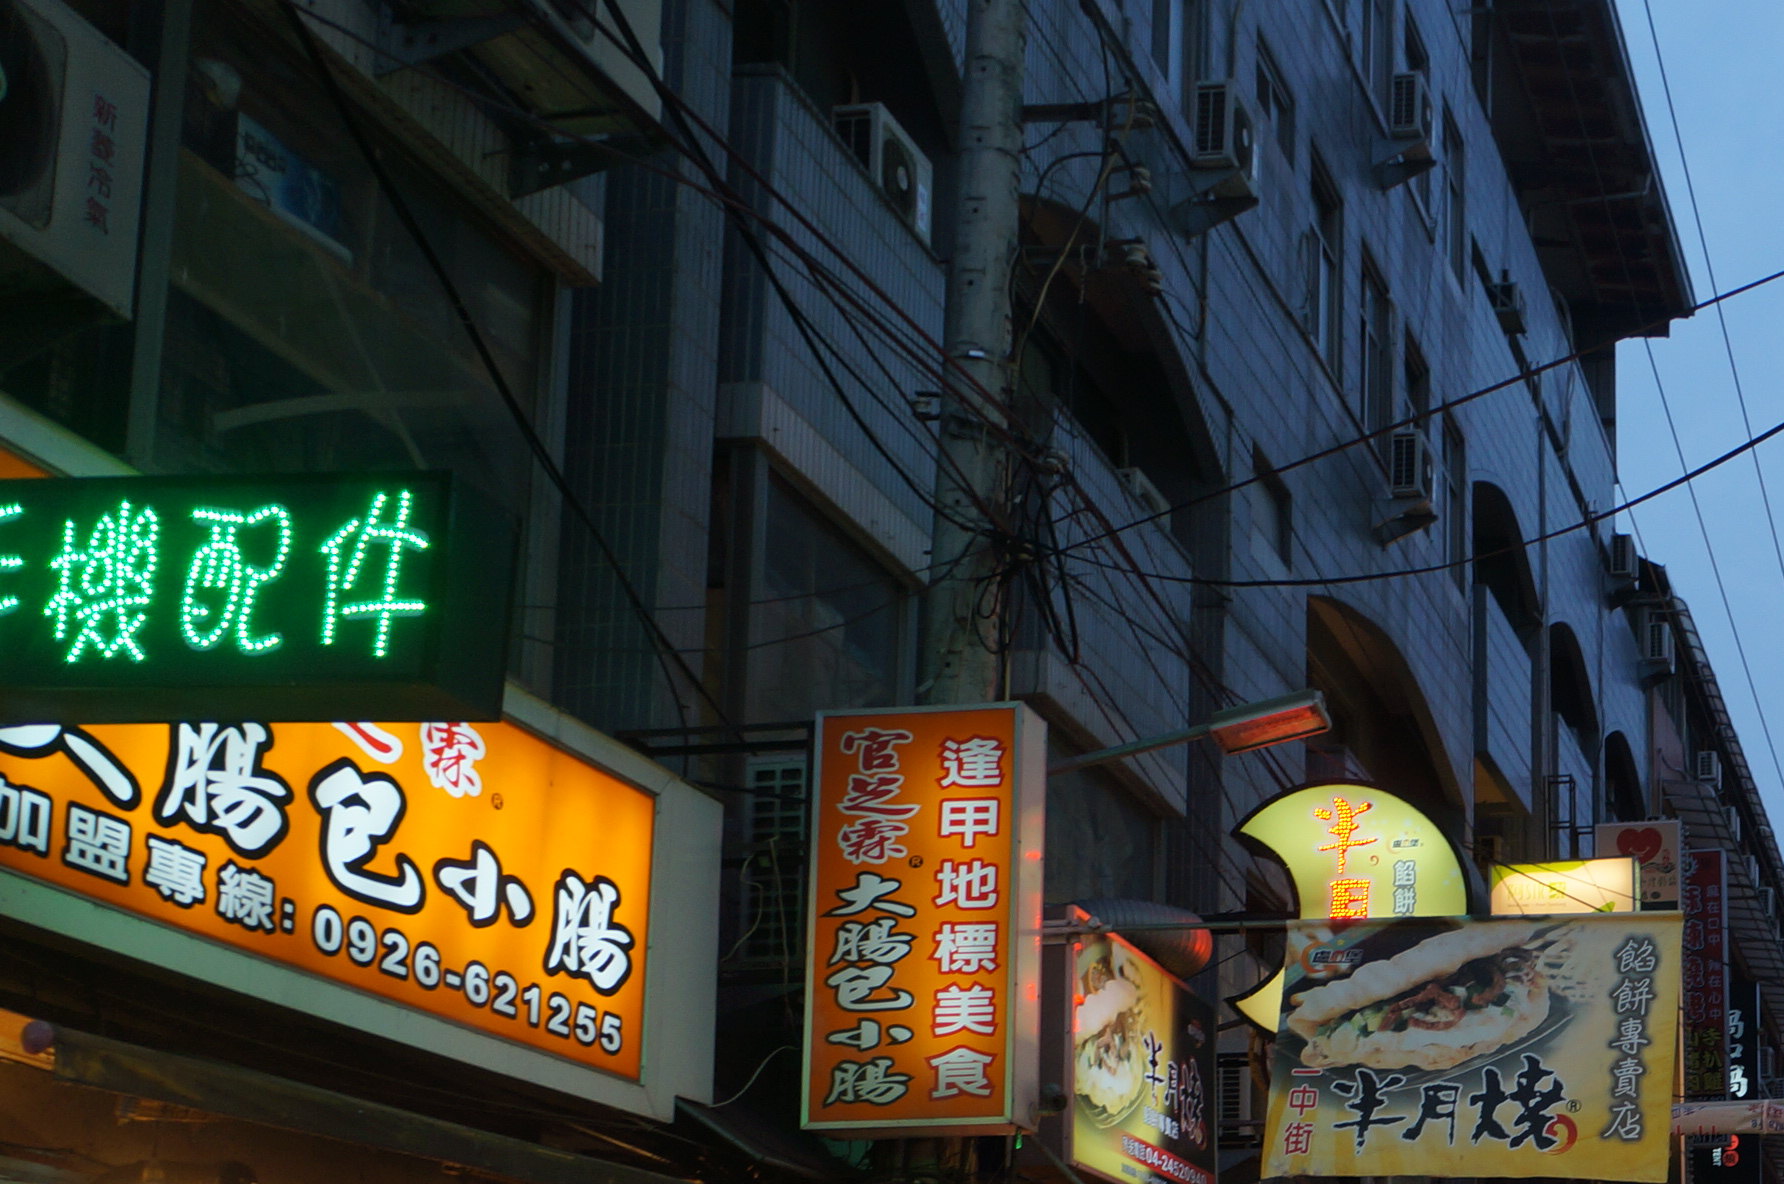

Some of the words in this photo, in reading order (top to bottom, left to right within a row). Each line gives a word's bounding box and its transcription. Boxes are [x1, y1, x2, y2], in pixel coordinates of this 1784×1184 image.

[837, 726, 921, 866] 官芝霖
[312, 908, 624, 1056] 0926-621255
[820, 870, 918, 1107] 大腸包小腸
[929, 735, 1004, 1101] 逢甲地標美食
[1283, 1067, 1326, 1157] 一中街
[1331, 1051, 1568, 1155] 半月燒
[1602, 935, 1660, 1143] 餡餅專賣店
